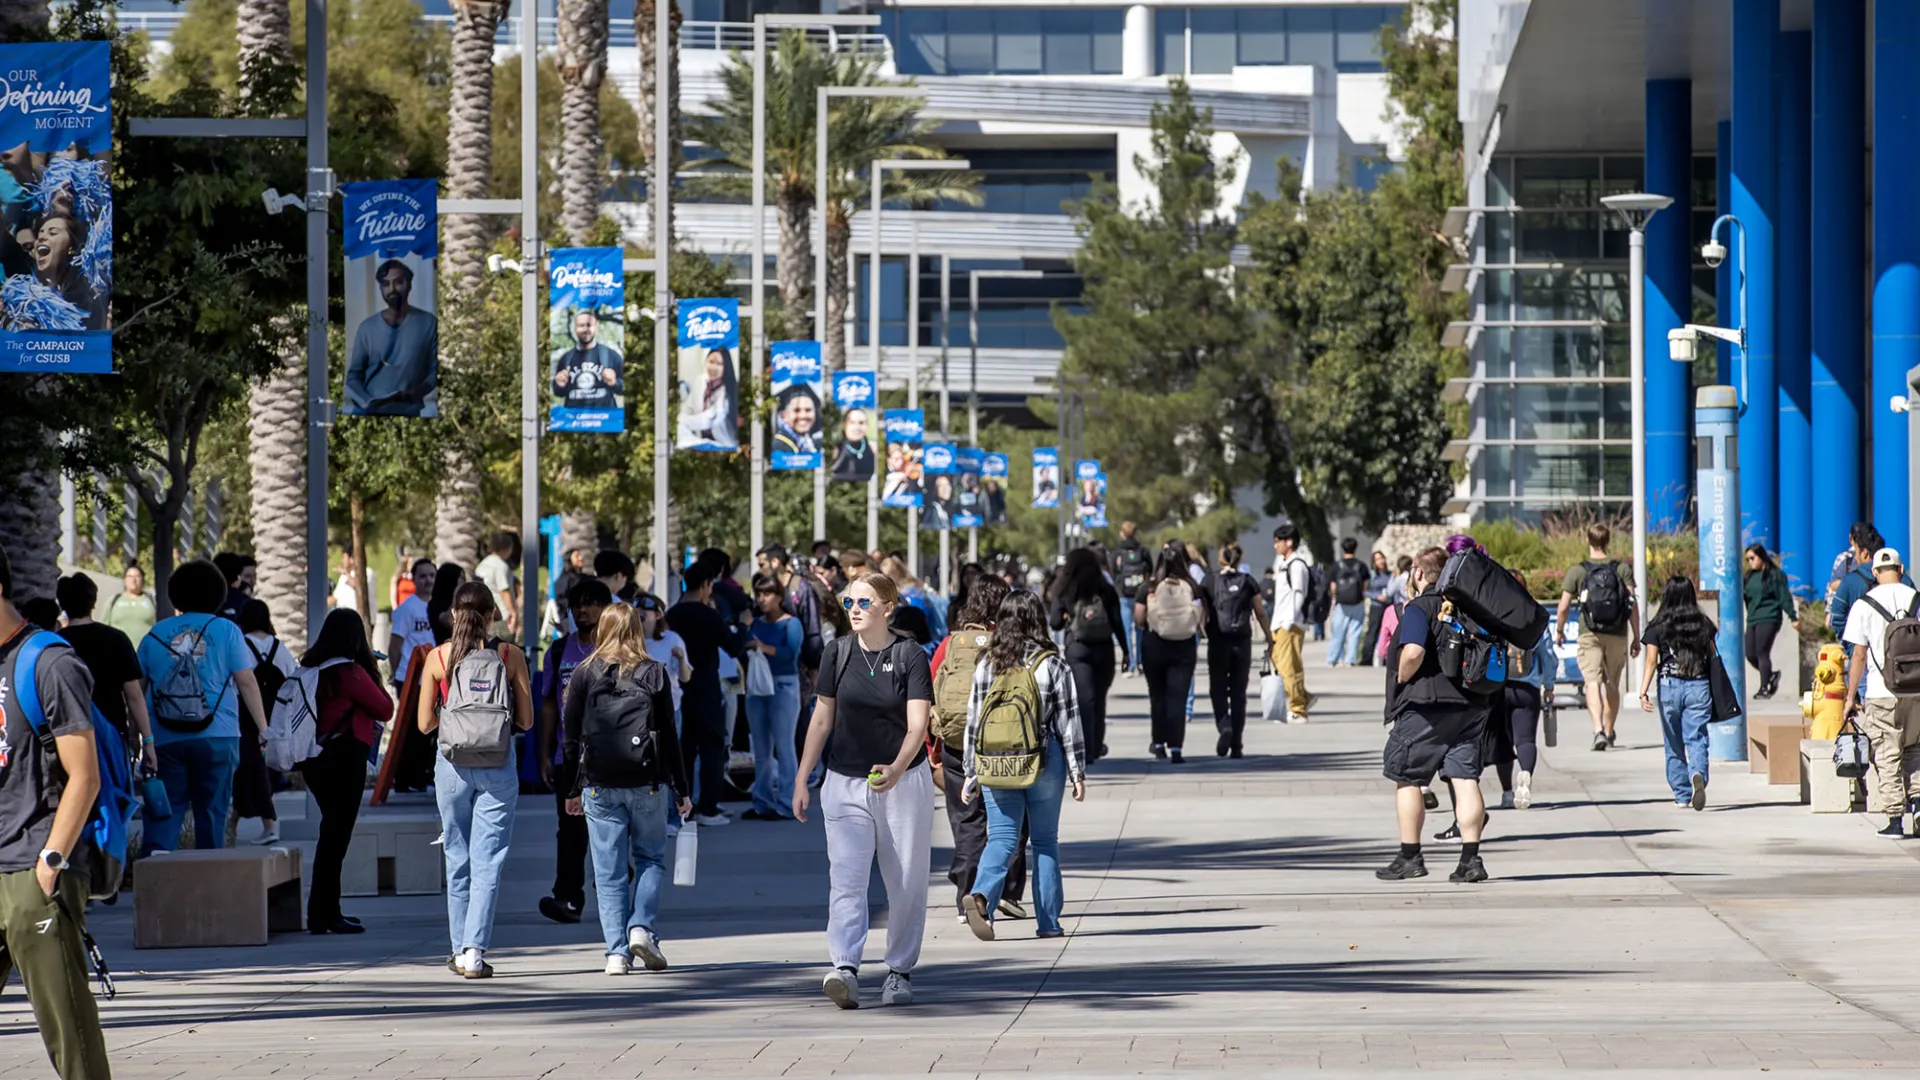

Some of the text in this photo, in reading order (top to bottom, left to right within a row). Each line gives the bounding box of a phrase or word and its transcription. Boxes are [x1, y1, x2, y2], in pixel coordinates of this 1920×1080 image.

[8, 69, 38, 81] OUR
[35, 116, 95, 129] MOMENT
[359, 192, 421, 211] WE DEFINE THE
[355, 210, 426, 241] Future
[552, 266, 622, 288] Defining
[685, 316, 732, 339] Future
[5, 340, 85, 351] The CAMPAIGN
[17, 352, 71, 366] for CSUSB
[1711, 475, 1727, 577] Emergency
[978, 756, 1035, 777] PINK
